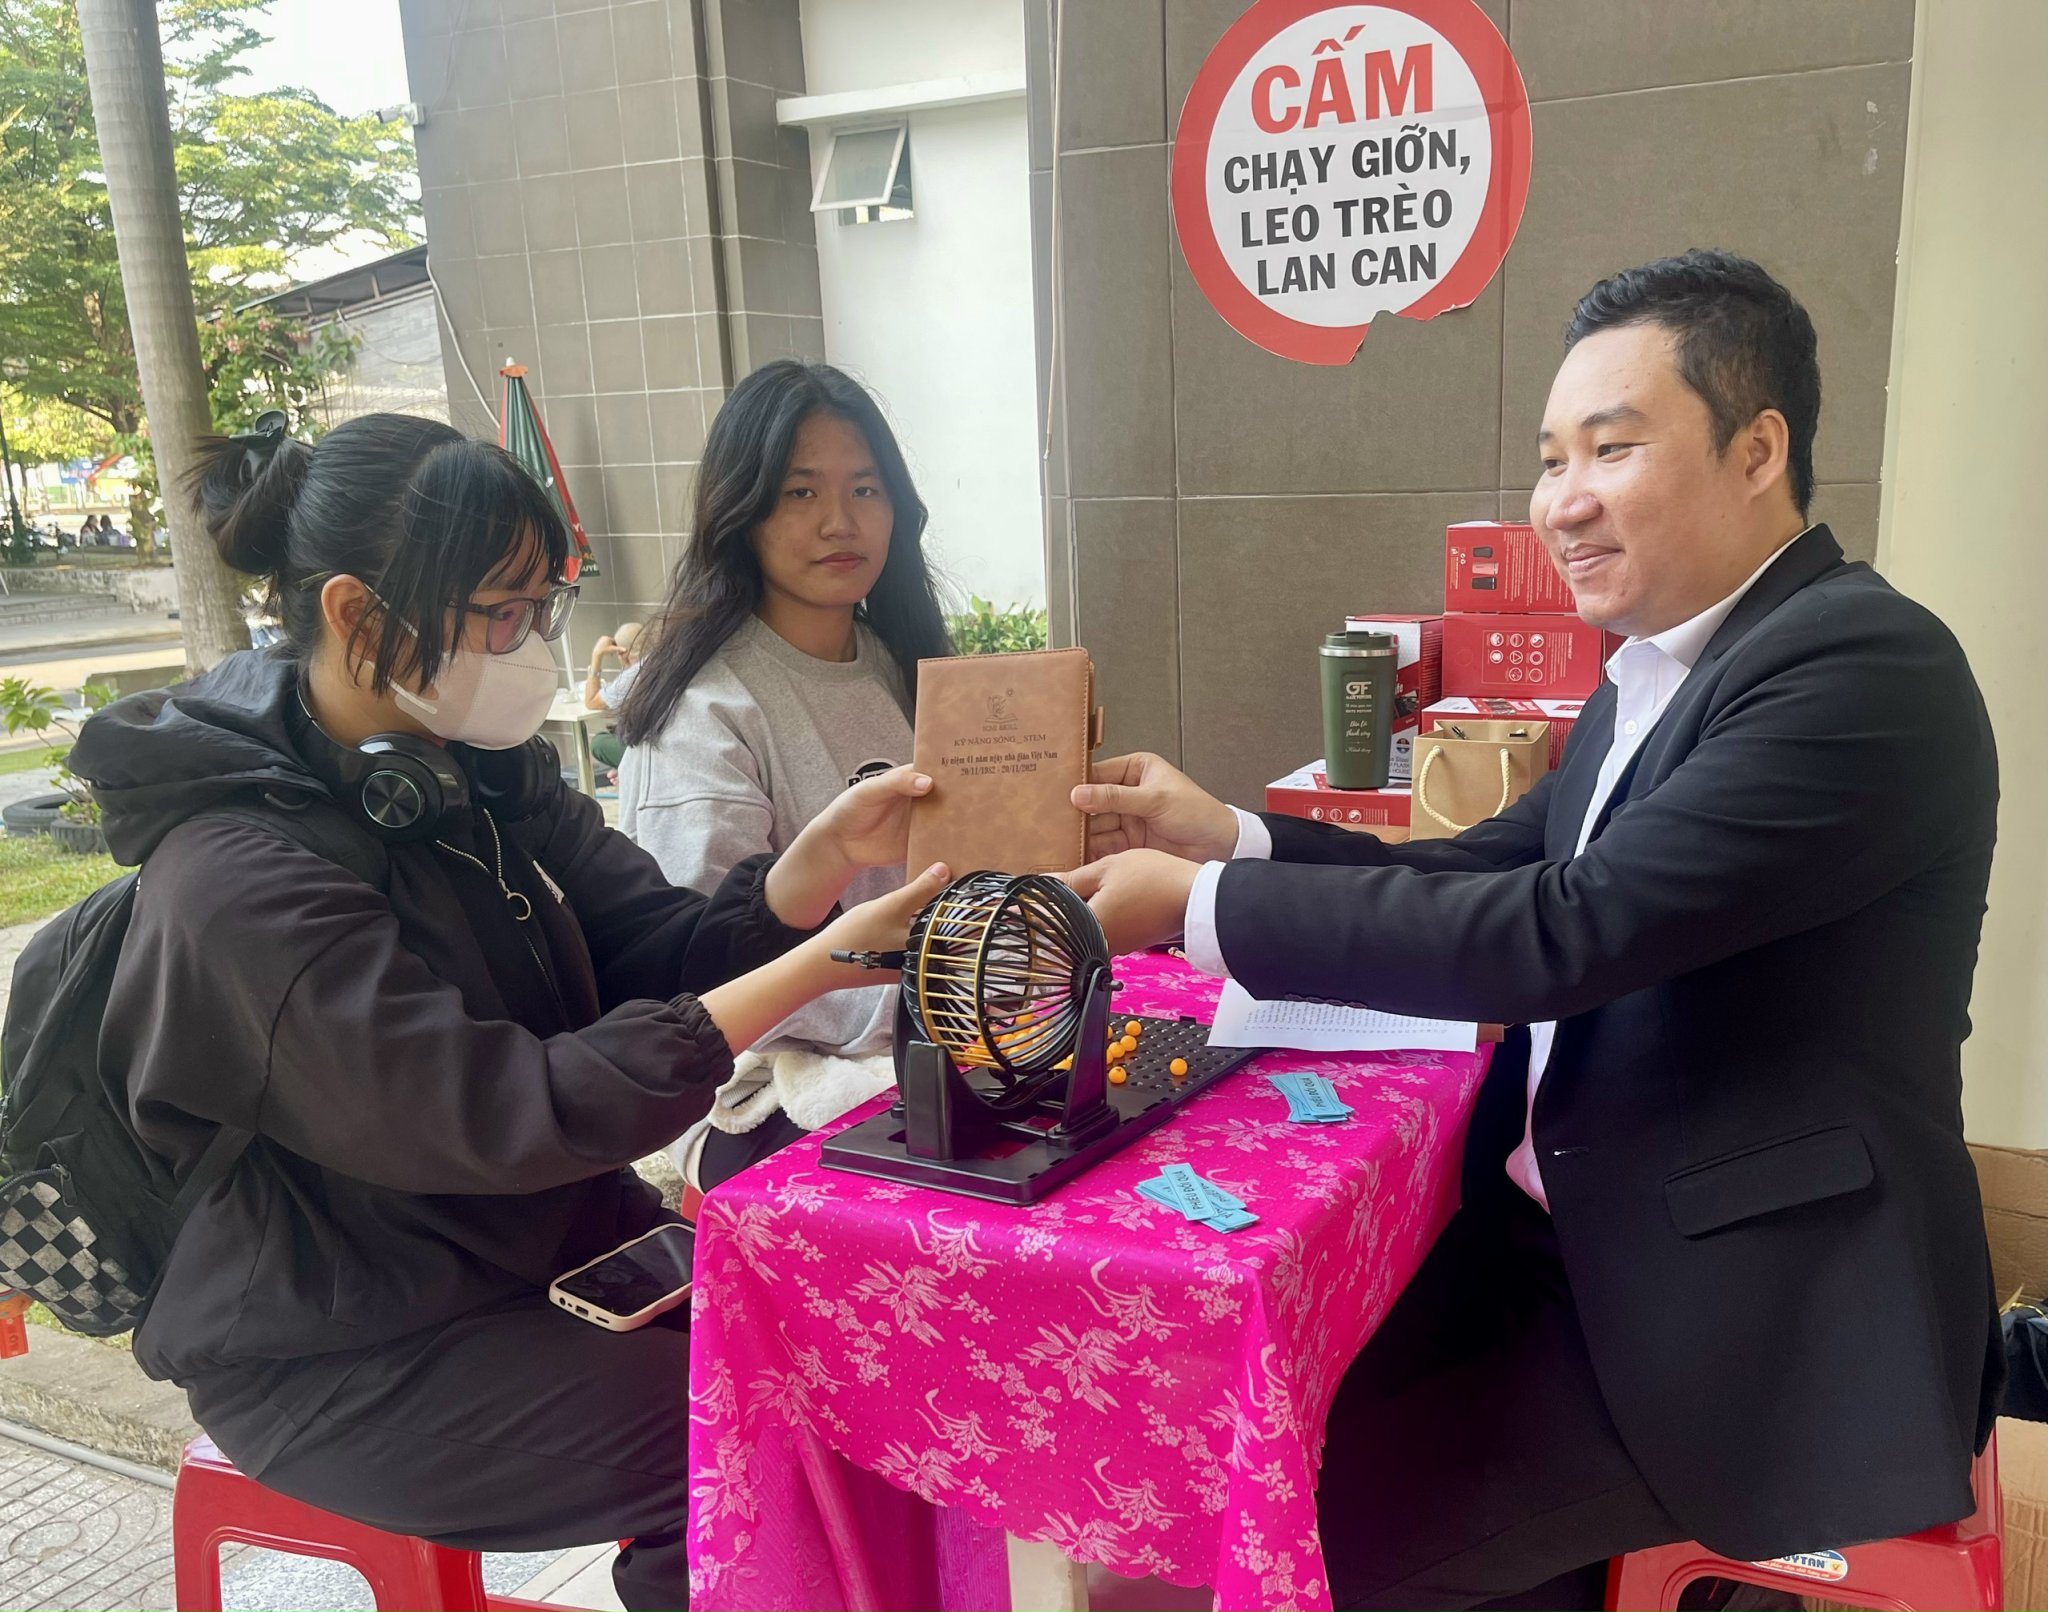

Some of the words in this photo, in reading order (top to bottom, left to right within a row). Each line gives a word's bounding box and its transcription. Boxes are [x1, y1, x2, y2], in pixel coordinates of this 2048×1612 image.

[1251, 24, 1433, 134] CẤM
[1224, 144, 1336, 195] CHẠY
[1351, 123, 1471, 179] GIỠN,
[1240, 204, 1320, 248] LEO
[1333, 183, 1453, 238] TRÈO
[1257, 252, 1336, 296] LAN
[1351, 242, 1437, 287] CAN
[1346, 681, 1372, 695] GF
[1023, 734, 1046, 743] STEM
[1043, 751, 1057, 759] Nam
[1783, 1555, 1825, 1568] UYTAN
